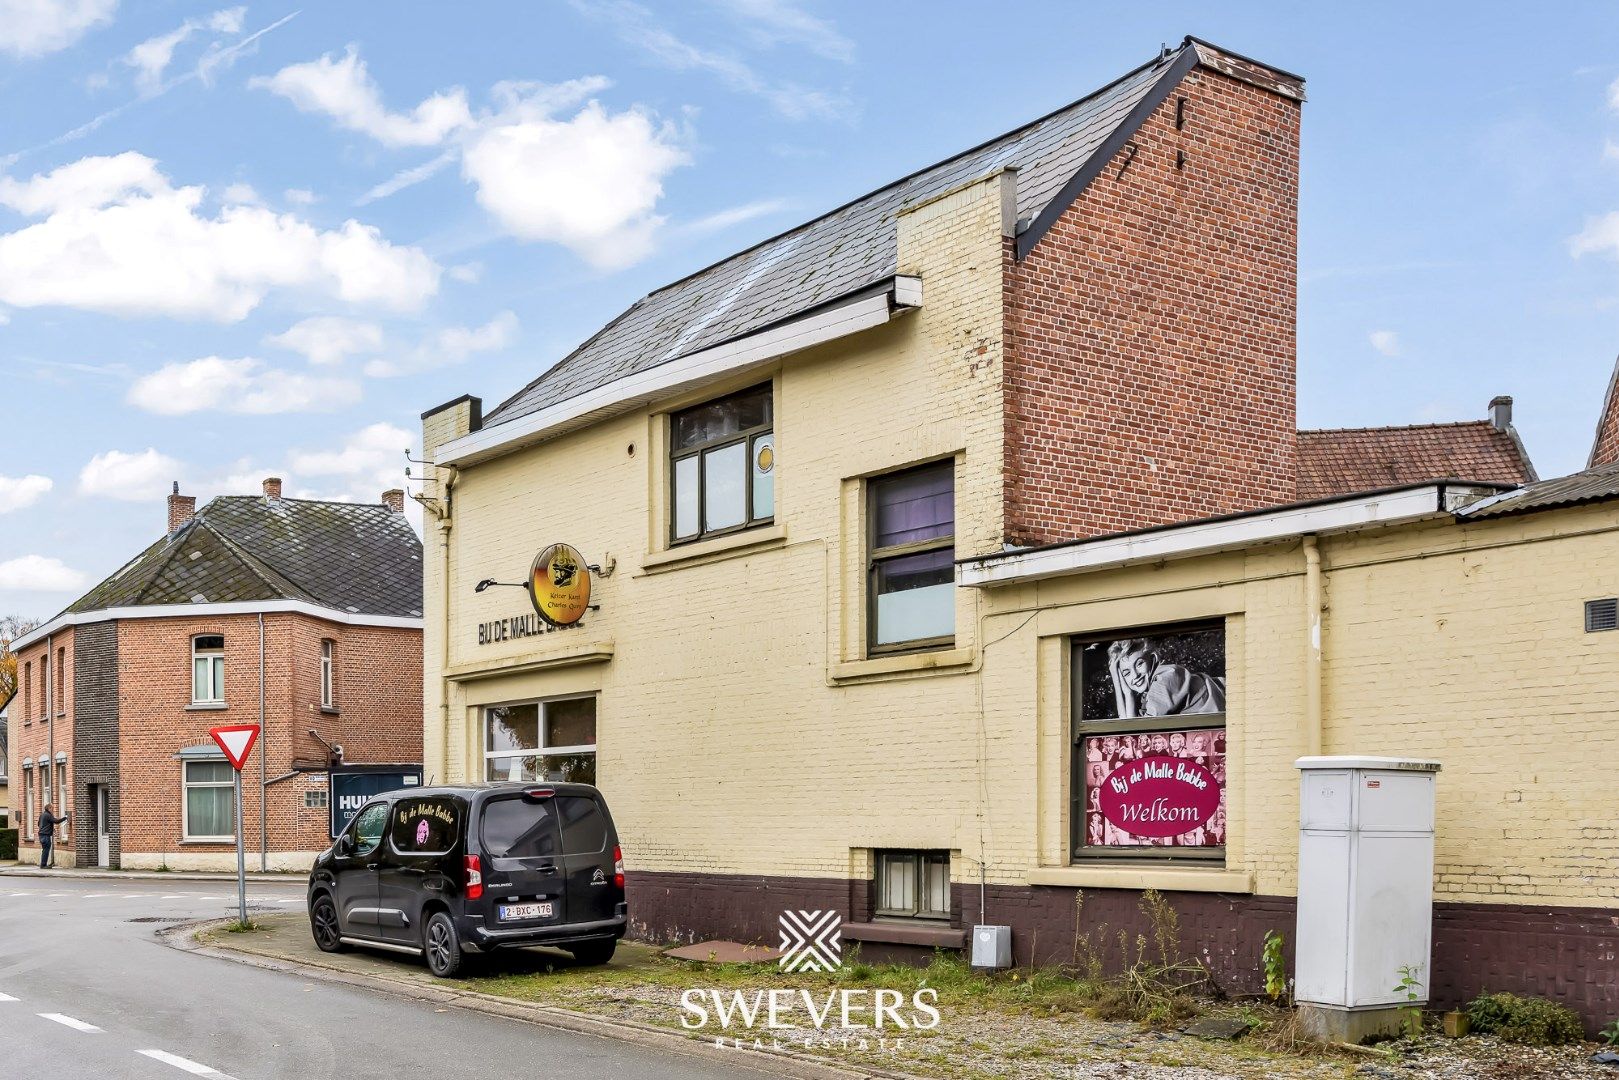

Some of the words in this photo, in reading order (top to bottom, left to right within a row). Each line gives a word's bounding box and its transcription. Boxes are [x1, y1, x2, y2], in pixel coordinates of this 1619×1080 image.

[494, 618, 508, 642] DE
[510, 613, 545, 640] MALLE
[1110, 776, 1129, 795] Bij
[1130, 768, 1143, 785] de
[1144, 760, 1174, 780] Malle
[1175, 762, 1208, 791] Babbe
[409, 807, 417, 818] de
[417, 804, 435, 815] Malle
[435, 805, 454, 824] Babbe
[1119, 798, 1200, 822] Welkom
